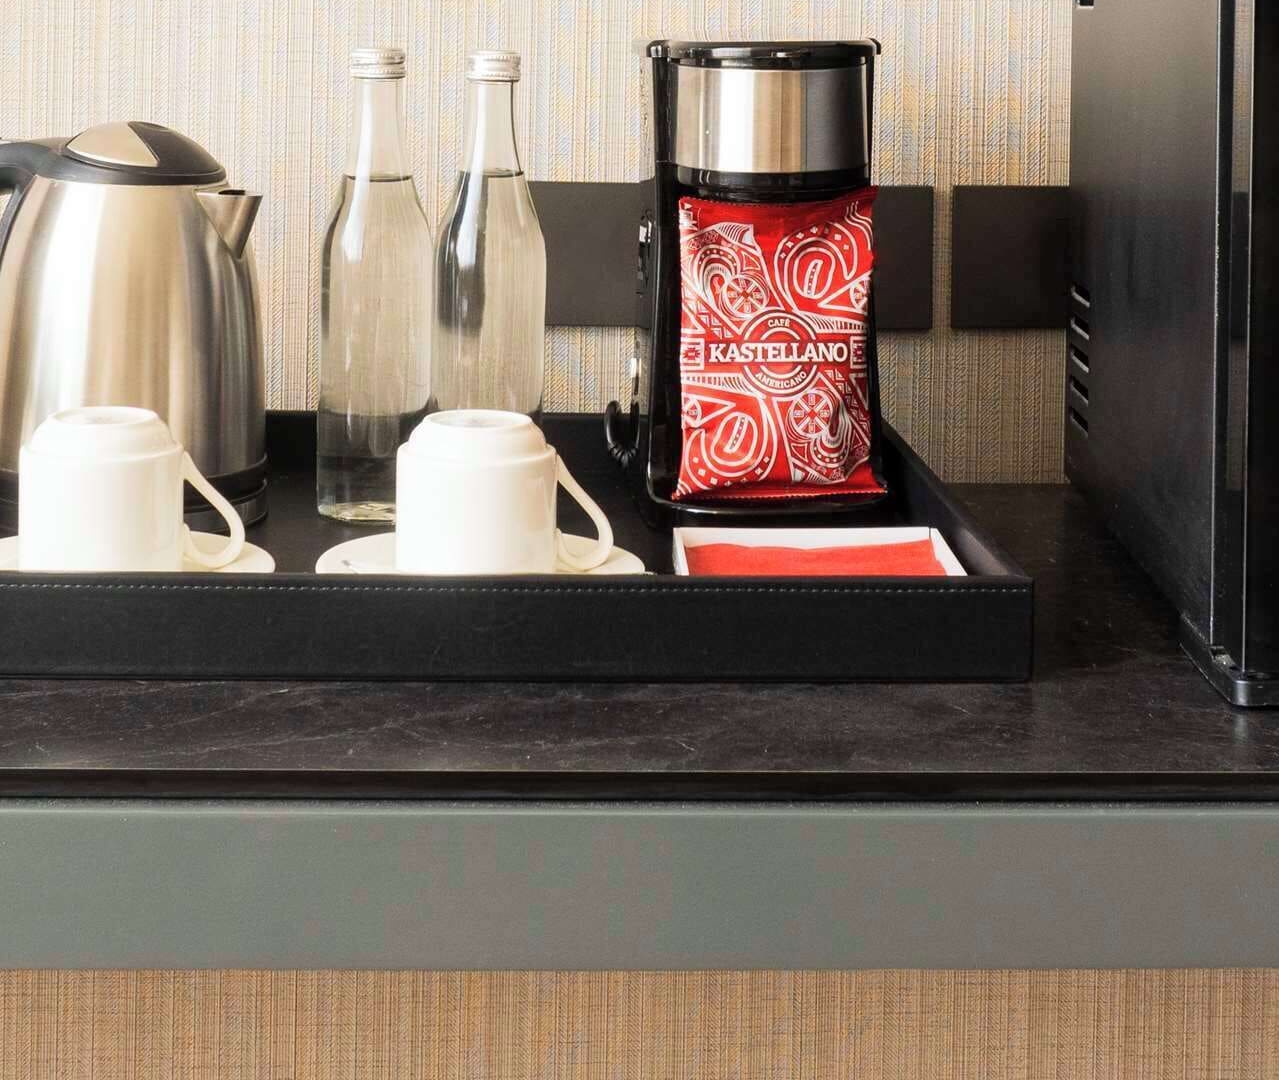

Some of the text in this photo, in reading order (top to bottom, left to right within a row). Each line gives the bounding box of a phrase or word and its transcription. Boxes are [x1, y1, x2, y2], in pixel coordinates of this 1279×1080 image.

[767, 319, 791, 328] CAFÉ
[709, 342, 848, 362] KASTELLANO
[755, 370, 808, 389] AMERICANO
